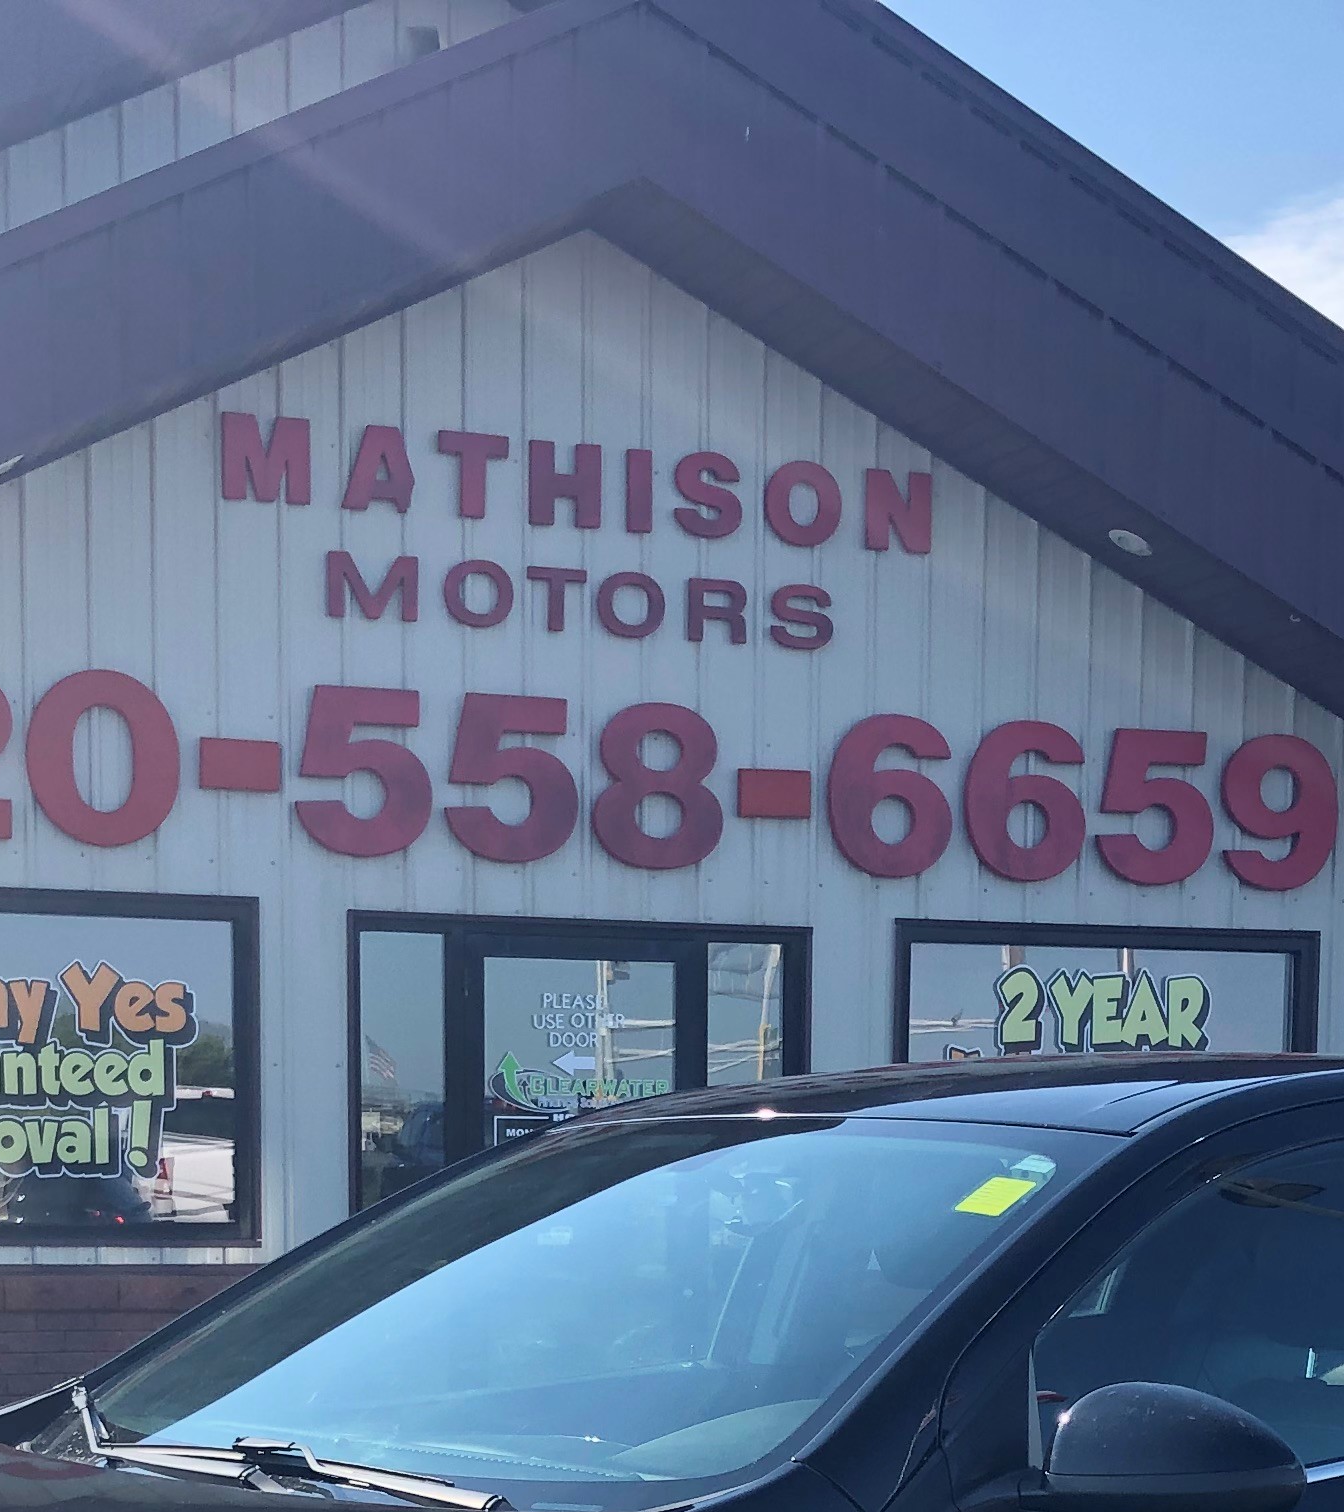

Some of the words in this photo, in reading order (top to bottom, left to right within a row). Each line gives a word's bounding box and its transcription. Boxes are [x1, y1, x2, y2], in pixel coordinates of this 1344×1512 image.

[220, 411, 935, 556] MATHISON
[324, 549, 836, 652] MOTORS
[60, 960, 197, 1040] Yes
[533, 1014, 565, 1030] USE
[549, 1032, 599, 1048] DOOR
[999, 967, 1044, 1049] 2
[1048, 969, 1210, 1050] YEAR
[529, 1074, 671, 1097] CLEARWATER
